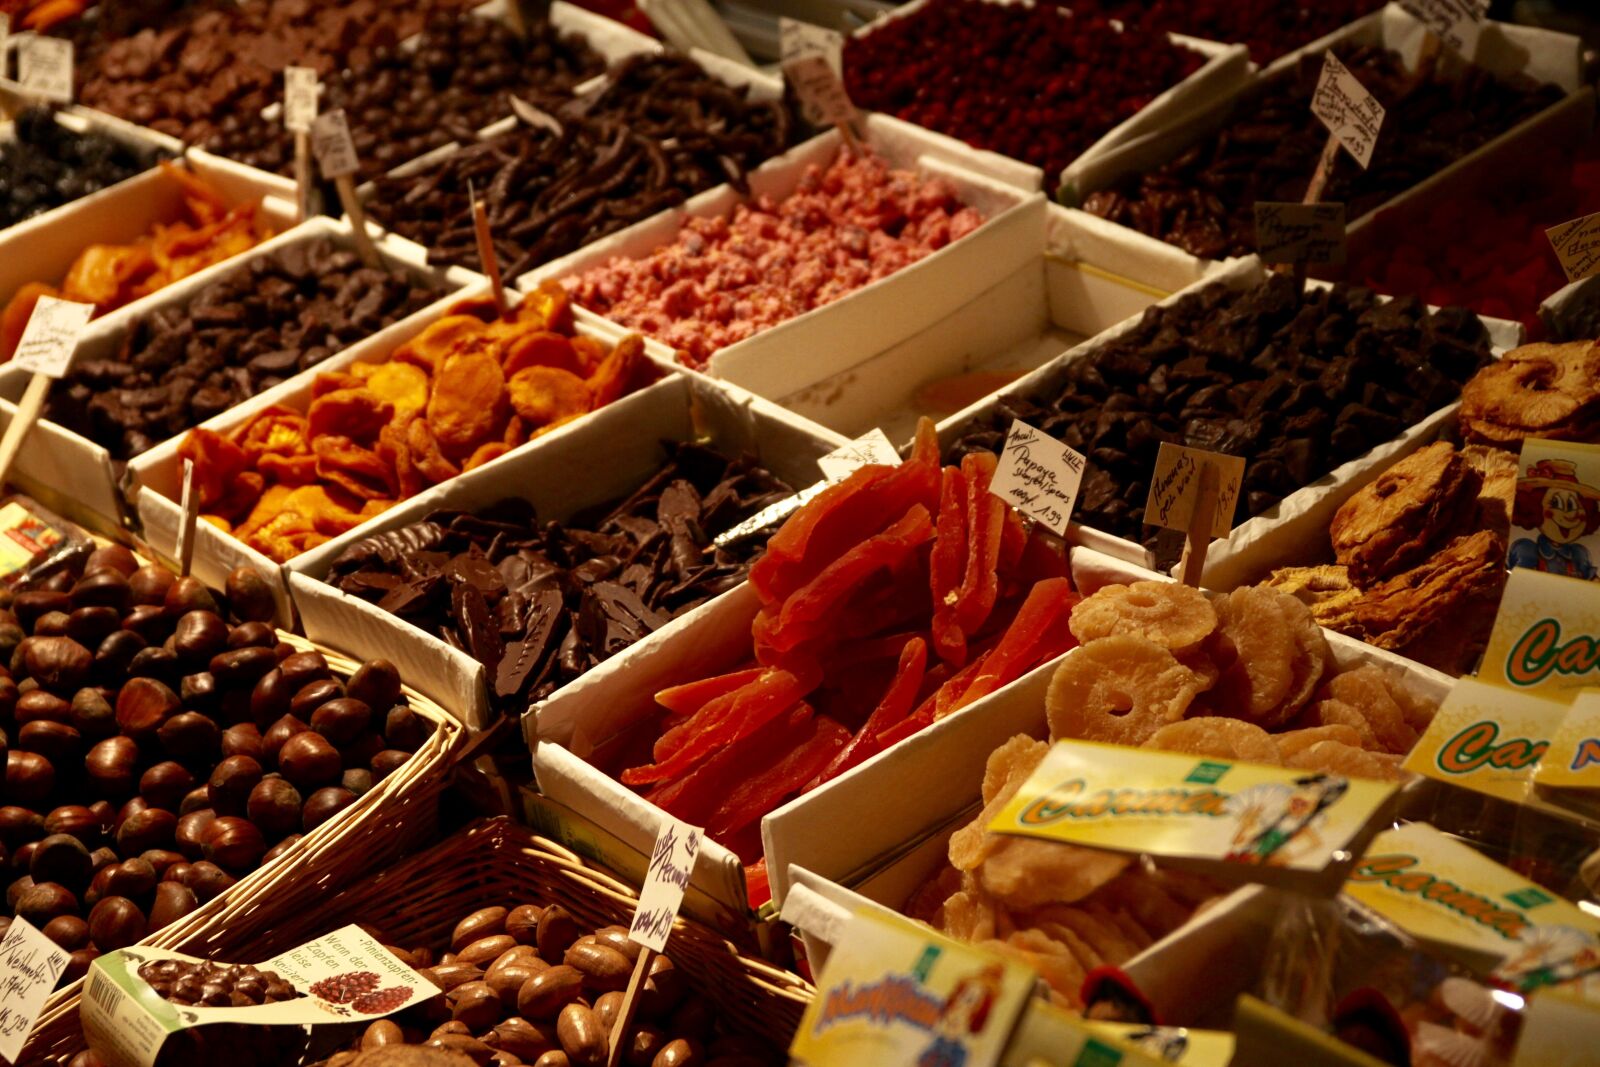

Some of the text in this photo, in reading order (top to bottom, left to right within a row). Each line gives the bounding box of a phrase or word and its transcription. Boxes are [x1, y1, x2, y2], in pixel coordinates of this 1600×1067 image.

[1013, 446, 1058, 484] Papaya
[289, 950, 312, 969] leise
[306, 942, 340, 970] Zapfen
[325, 935, 368, 970] Wenn der
